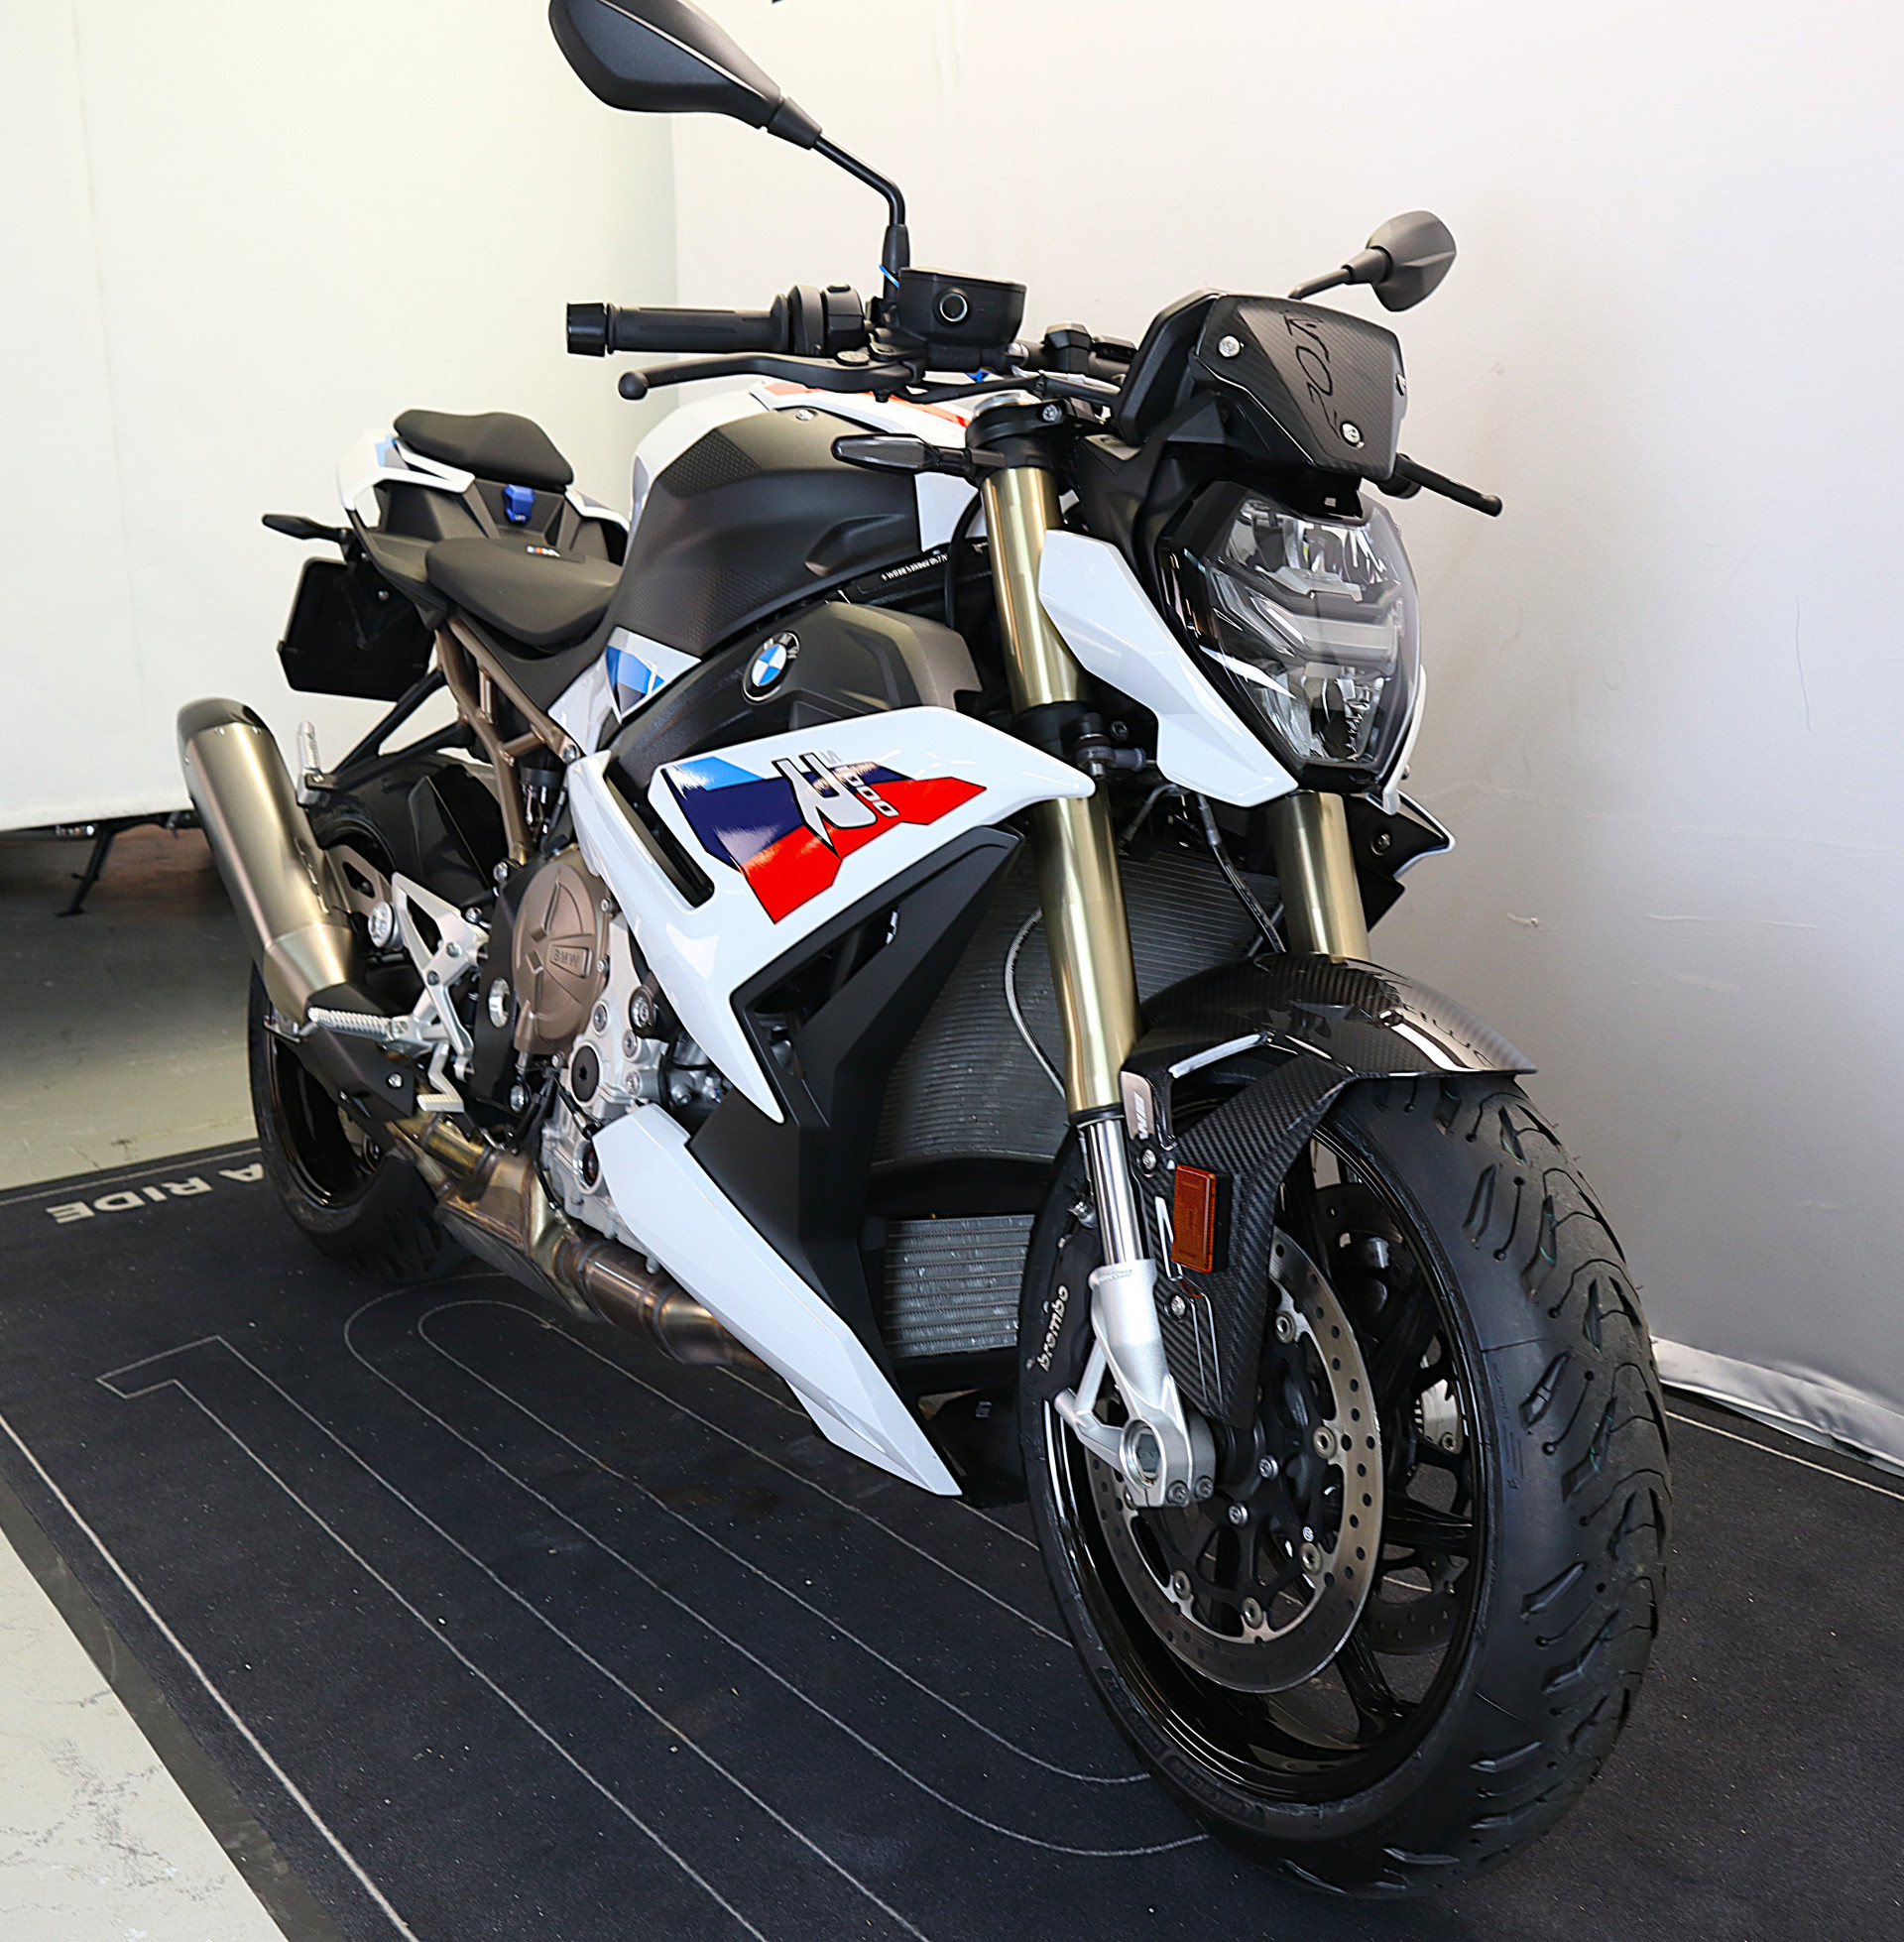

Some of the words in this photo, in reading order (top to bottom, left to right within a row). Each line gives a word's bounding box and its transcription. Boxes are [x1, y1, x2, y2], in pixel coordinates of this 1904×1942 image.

[763, 632, 800, 660] BMW
[771, 752, 879, 859] R
[218, 1163, 265, 1182] A
[45, 1176, 213, 1224] RIDE
[1036, 1284, 1070, 1373] brembo
